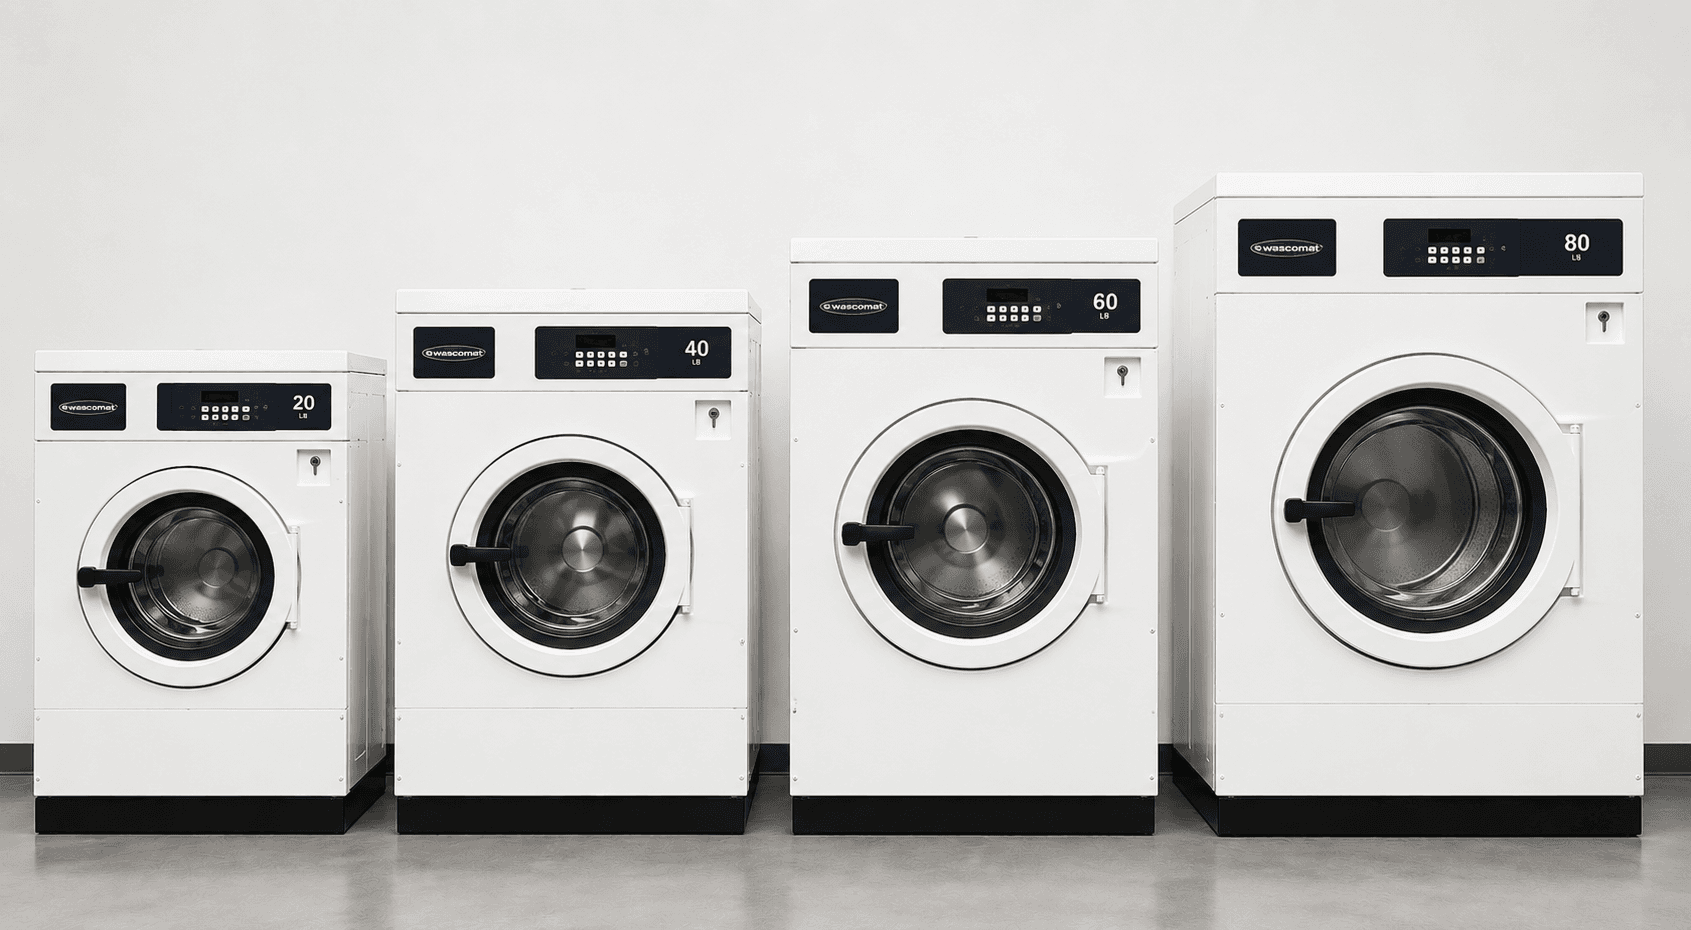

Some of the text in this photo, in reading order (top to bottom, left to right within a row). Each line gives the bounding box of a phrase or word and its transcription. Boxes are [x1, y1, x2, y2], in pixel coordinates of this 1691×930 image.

[1564, 233, 1590, 251] 80
[1093, 292, 1118, 311] 60
[684, 339, 709, 357] 40
[292, 394, 315, 411] 20
